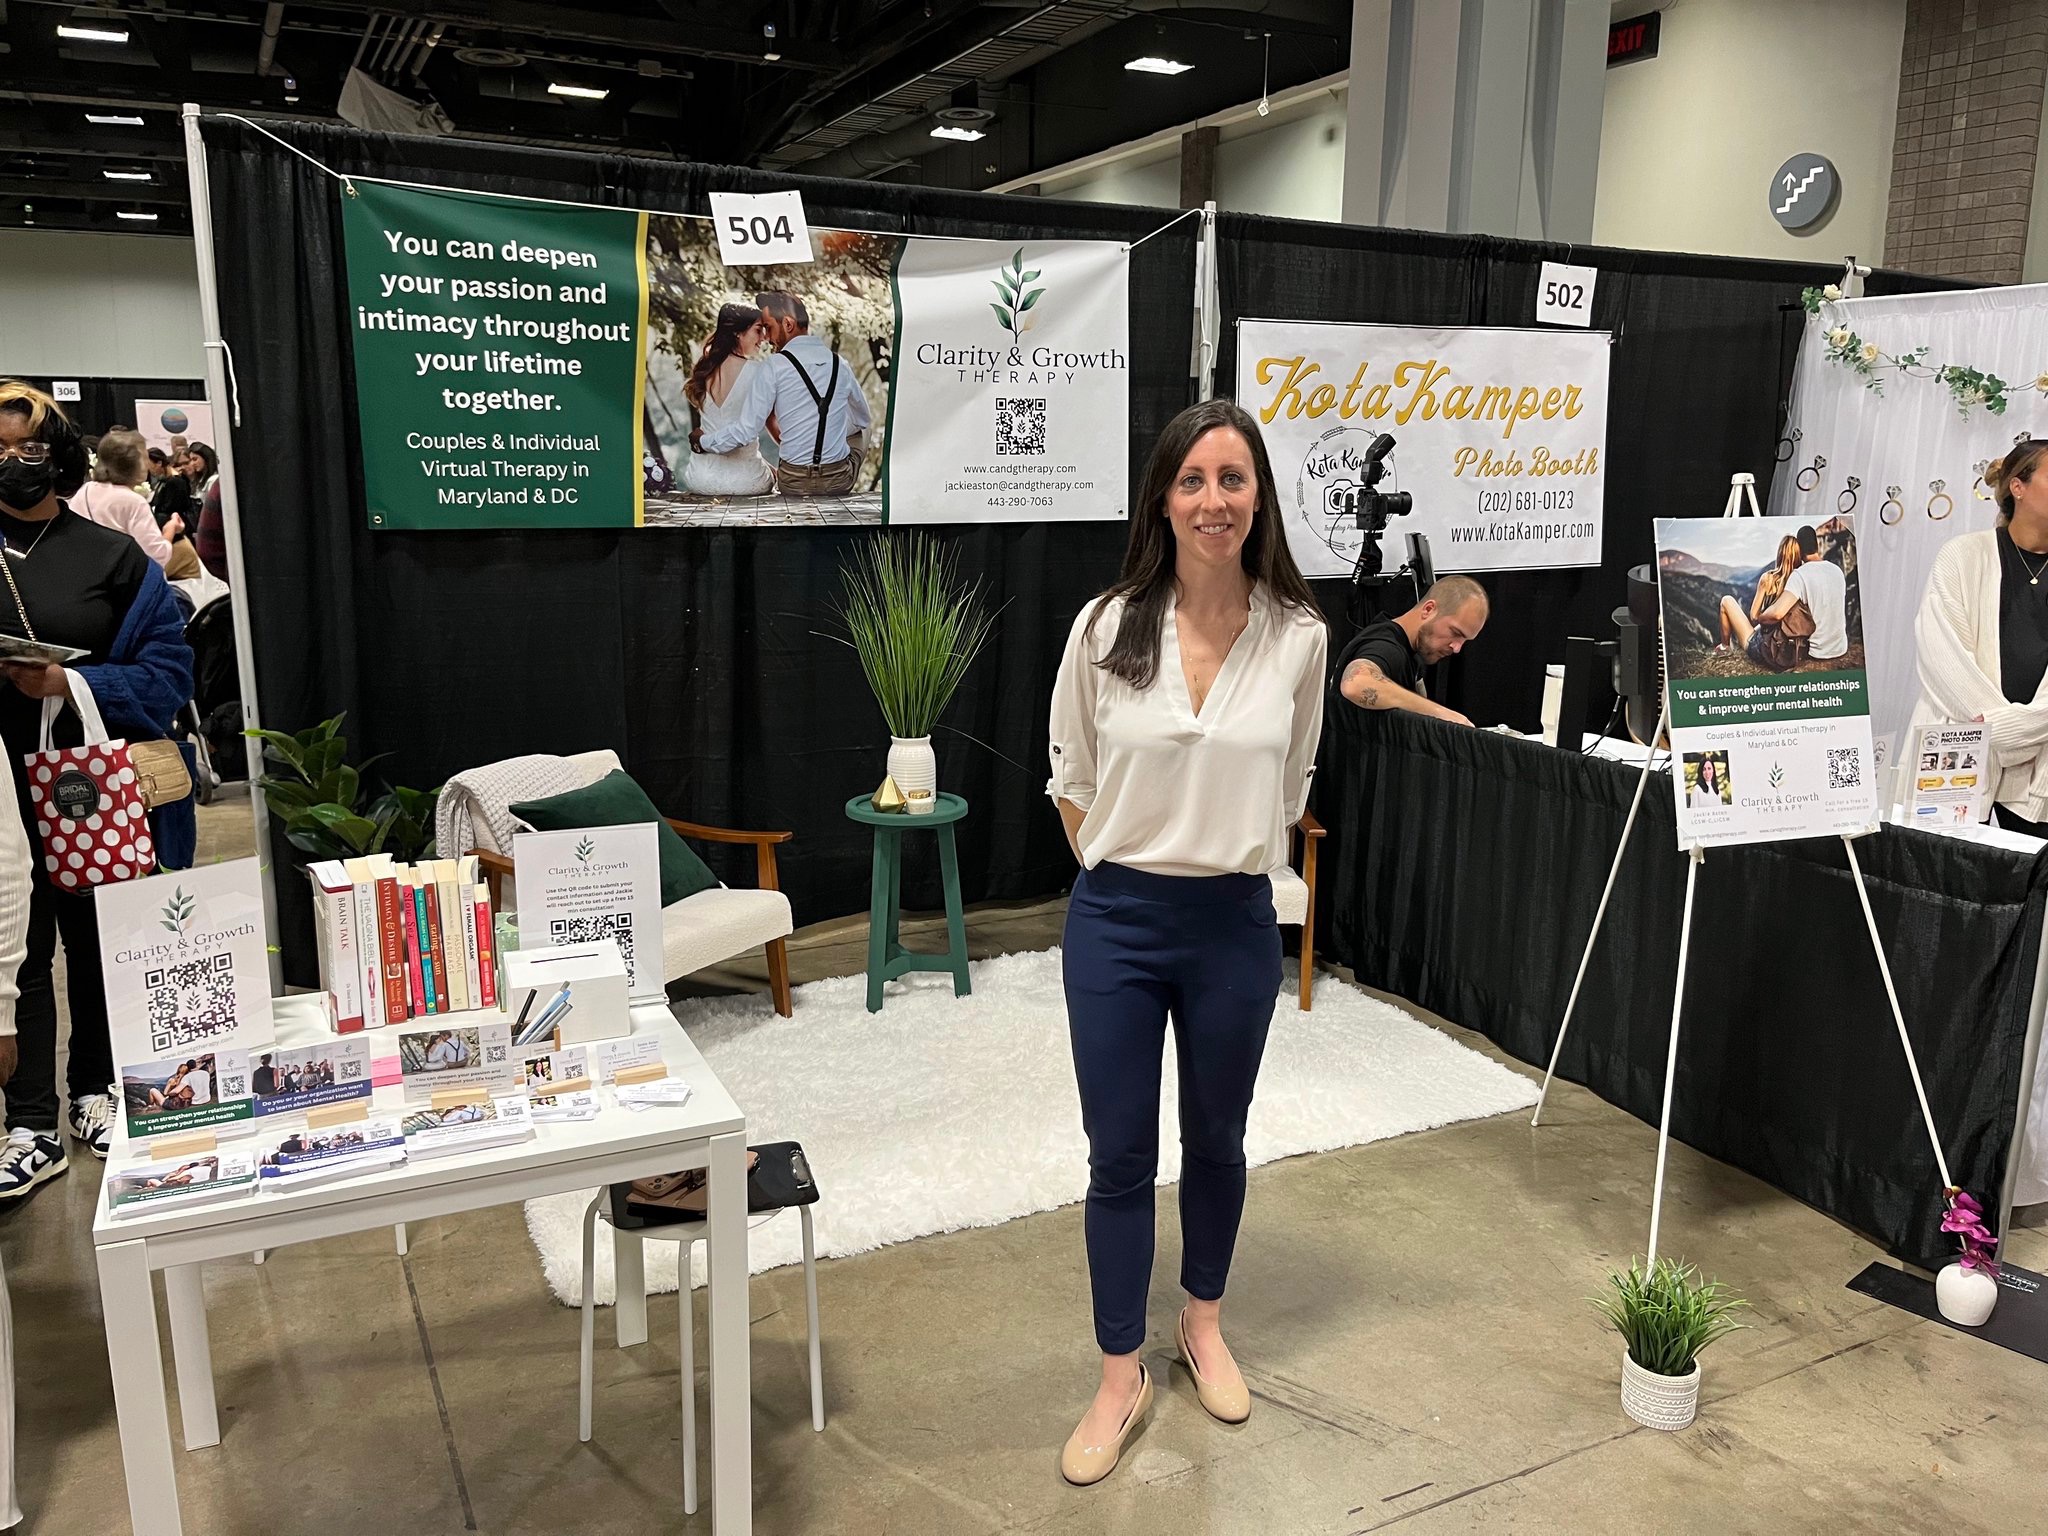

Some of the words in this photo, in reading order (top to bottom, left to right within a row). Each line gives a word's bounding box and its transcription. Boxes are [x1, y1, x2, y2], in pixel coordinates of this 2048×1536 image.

[729, 215, 794, 246] 504
[384, 230, 437, 256] You
[446, 238, 494, 260] can
[501, 240, 598, 270] deepen
[380, 273, 443, 297] your
[451, 277, 552, 302] passion
[559, 283, 607, 304] and
[1545, 282, 1583, 309] 502
[358, 306, 477, 340] intimacy
[483, 314, 631, 344] throughout
[415, 351, 477, 376] your
[484, 350, 582, 376] lifetime
[917, 343, 1000, 372] Clarity
[1007, 347, 1024, 368] &
[1032, 347, 1126, 370] Growth
[958, 369, 1076, 385] THERAPY
[57, 387, 76, 396] 306
[442, 388, 561, 414] together.
[406, 432, 487, 453] Couples
[492, 434, 505, 449] &
[509, 433, 600, 452] Individual
[421, 460, 488, 478] Virtual
[492, 461, 568, 481] Therapy
[573, 462, 590, 478] in
[963, 463, 1077, 475] www.candgtherapy.com
[1307, 453, 1338, 480] Kota
[1453, 446, 1524, 478] Photo
[1528, 445, 1598, 477] Booth
[944, 479, 1094, 492] jackieaston@candgtherapy.com
[438, 488, 528, 508] Maryland
[533, 489, 547, 504] &
[551, 488, 579, 504] DC
[987, 495, 1053, 507] 443-290-7063
[1478, 492, 1512, 514] (202)
[1516, 490, 1574, 511] 681-0123
[1451, 522, 1594, 544] www.KotaKamper.com
[1677, 689, 1697, 701] You
[1698, 689, 1717, 699] can
[1719, 685, 1772, 699] strengthen
[1774, 685, 1797, 697] your
[1798, 680, 1860, 694] relationships
[1699, 704, 1707, 715] &
[1709, 703, 1750, 716] improve
[1751, 702, 1774, 714] your
[1776, 699, 1810, 711] mental
[1812, 696, 1842, 707] health
[1706, 731, 1734, 741] Couples
[1742, 727, 1776, 738] Individual
[1777, 727, 1800, 736] Virtual
[1802, 725, 1828, 735] Therapy
[1830, 724, 1836, 732] in
[1748, 740, 1780, 751] Maryland
[1788, 738, 1798, 746] DC
[59, 784, 89, 796] BRIDAL
[1741, 796, 1774, 808] Clarity
[1776, 795, 1782, 803] &
[1785, 792, 1819, 804] Growth
[1756, 804, 1803, 814] THERAPY
[548, 866, 580, 876] Clarity
[583, 864, 591, 872] &
[592, 861, 628, 871] Growth
[384, 881, 392, 922] INTIMACY
[570, 891, 603, 899] information
[616, 887, 633, 895] Jackie
[337, 897, 347, 926] BRAIN
[363, 897, 371, 913] THE
[404, 892, 413, 917] Slow
[580, 905, 615, 913] consultation
[365, 913, 373, 947] VAGINA
[407, 921, 416, 939] Sex
[466, 912, 474, 933] FEMALE
[115, 943, 172, 965] Clarity
[177, 938, 190, 950] &
[194, 923, 255, 946] Growth
[340, 926, 350, 951] TALK
[387, 931, 396, 961] DESIRE
[144, 942, 223, 967] THERAPY
[367, 946, 376, 968] BIBLE
[445, 935, 455, 975] MARRIAGE
[454, 934, 464, 974] PASSIONATE
[432, 1079, 462, 1087] throughout
[272, 1098, 285, 1106] you
[293, 1094, 309, 1102] your
[309, 1087, 348, 1098] organization
[293, 1100, 312, 1108] about
[312, 1095, 335, 1105] Mental
[335, 1090, 359, 1100] Health?
[153, 1122, 179, 1131] improve
[179, 1119, 194, 1128] your
[194, 1115, 216, 1124] mental
[216, 1112, 236, 1121] health
[160, 1112, 193, 1122] strengthen
[193, 1110, 207, 1118] your
[208, 1103, 247, 1114] relationships
